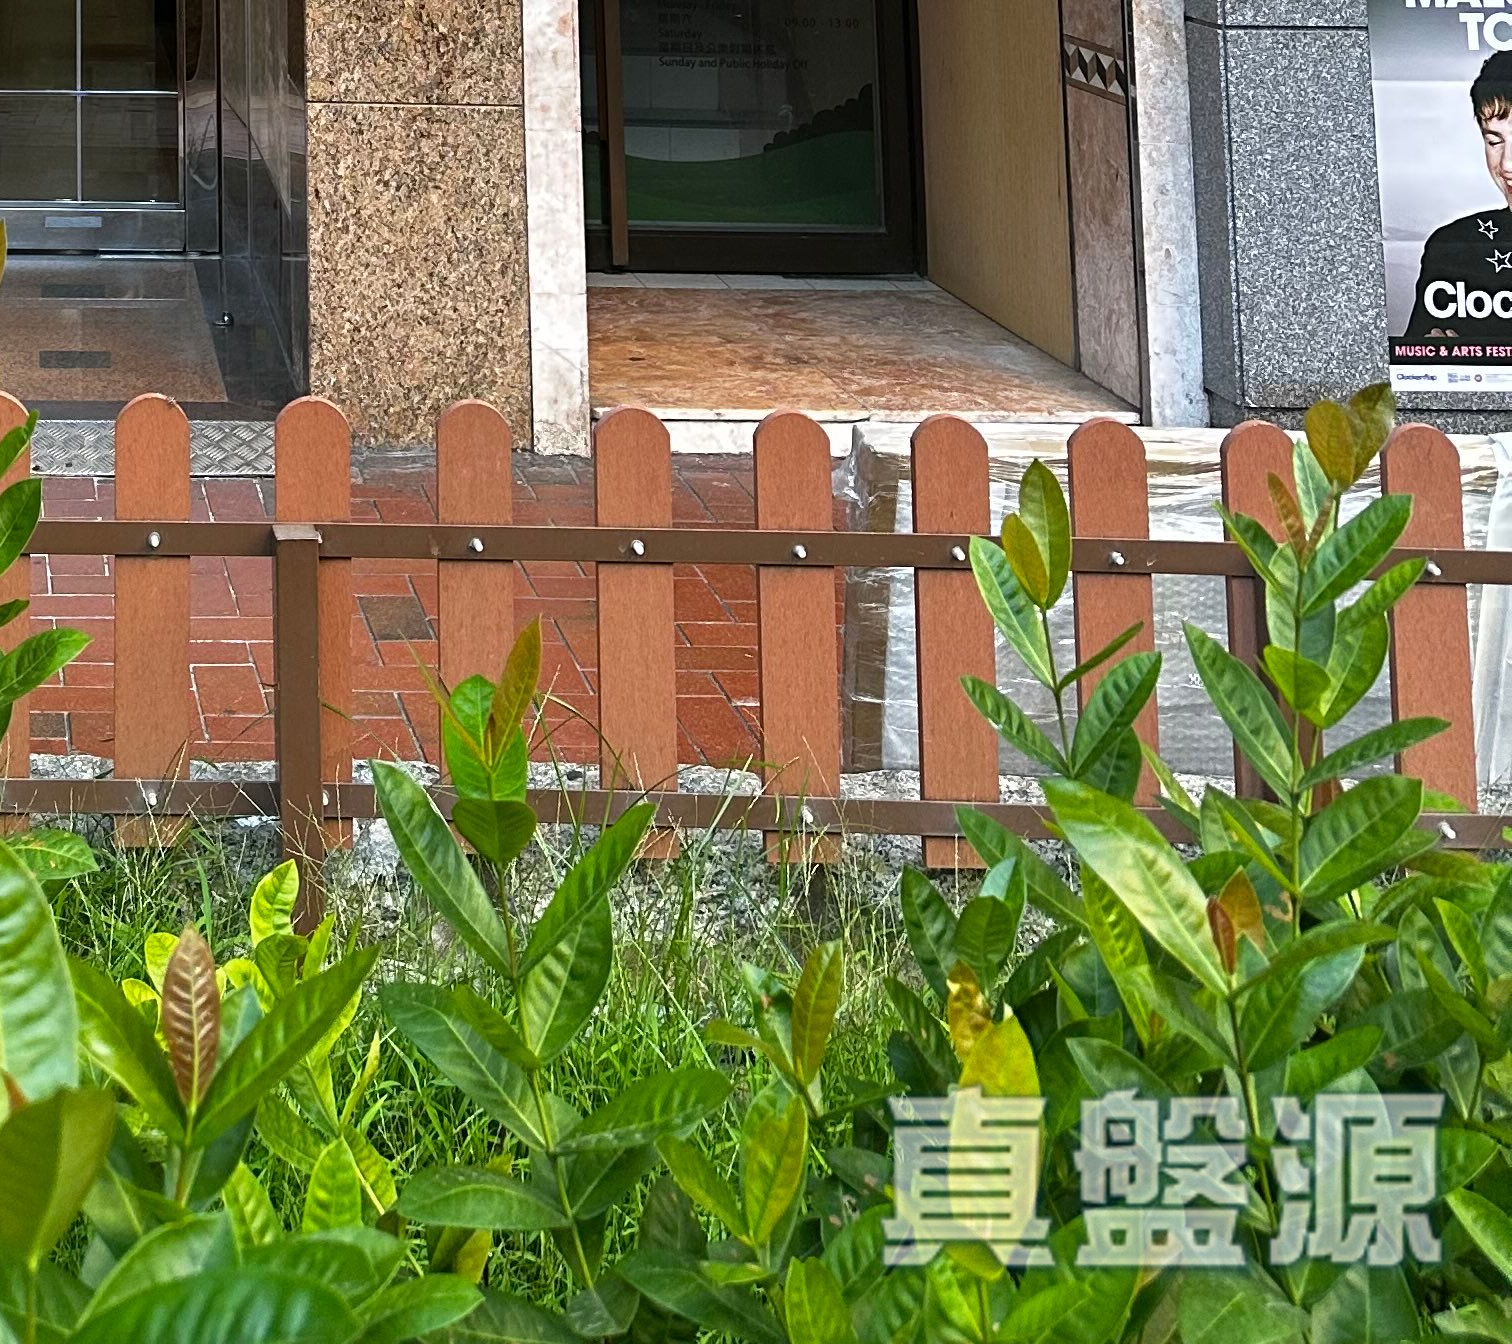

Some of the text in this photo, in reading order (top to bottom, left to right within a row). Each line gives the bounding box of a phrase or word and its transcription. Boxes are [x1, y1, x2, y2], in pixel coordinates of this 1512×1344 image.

[1423, 280, 1512, 319] Cloc
[1394, 345, 1436, 357] MUSIC
[1439, 345, 1448, 357] &
[1452, 345, 1483, 357] ARTS
